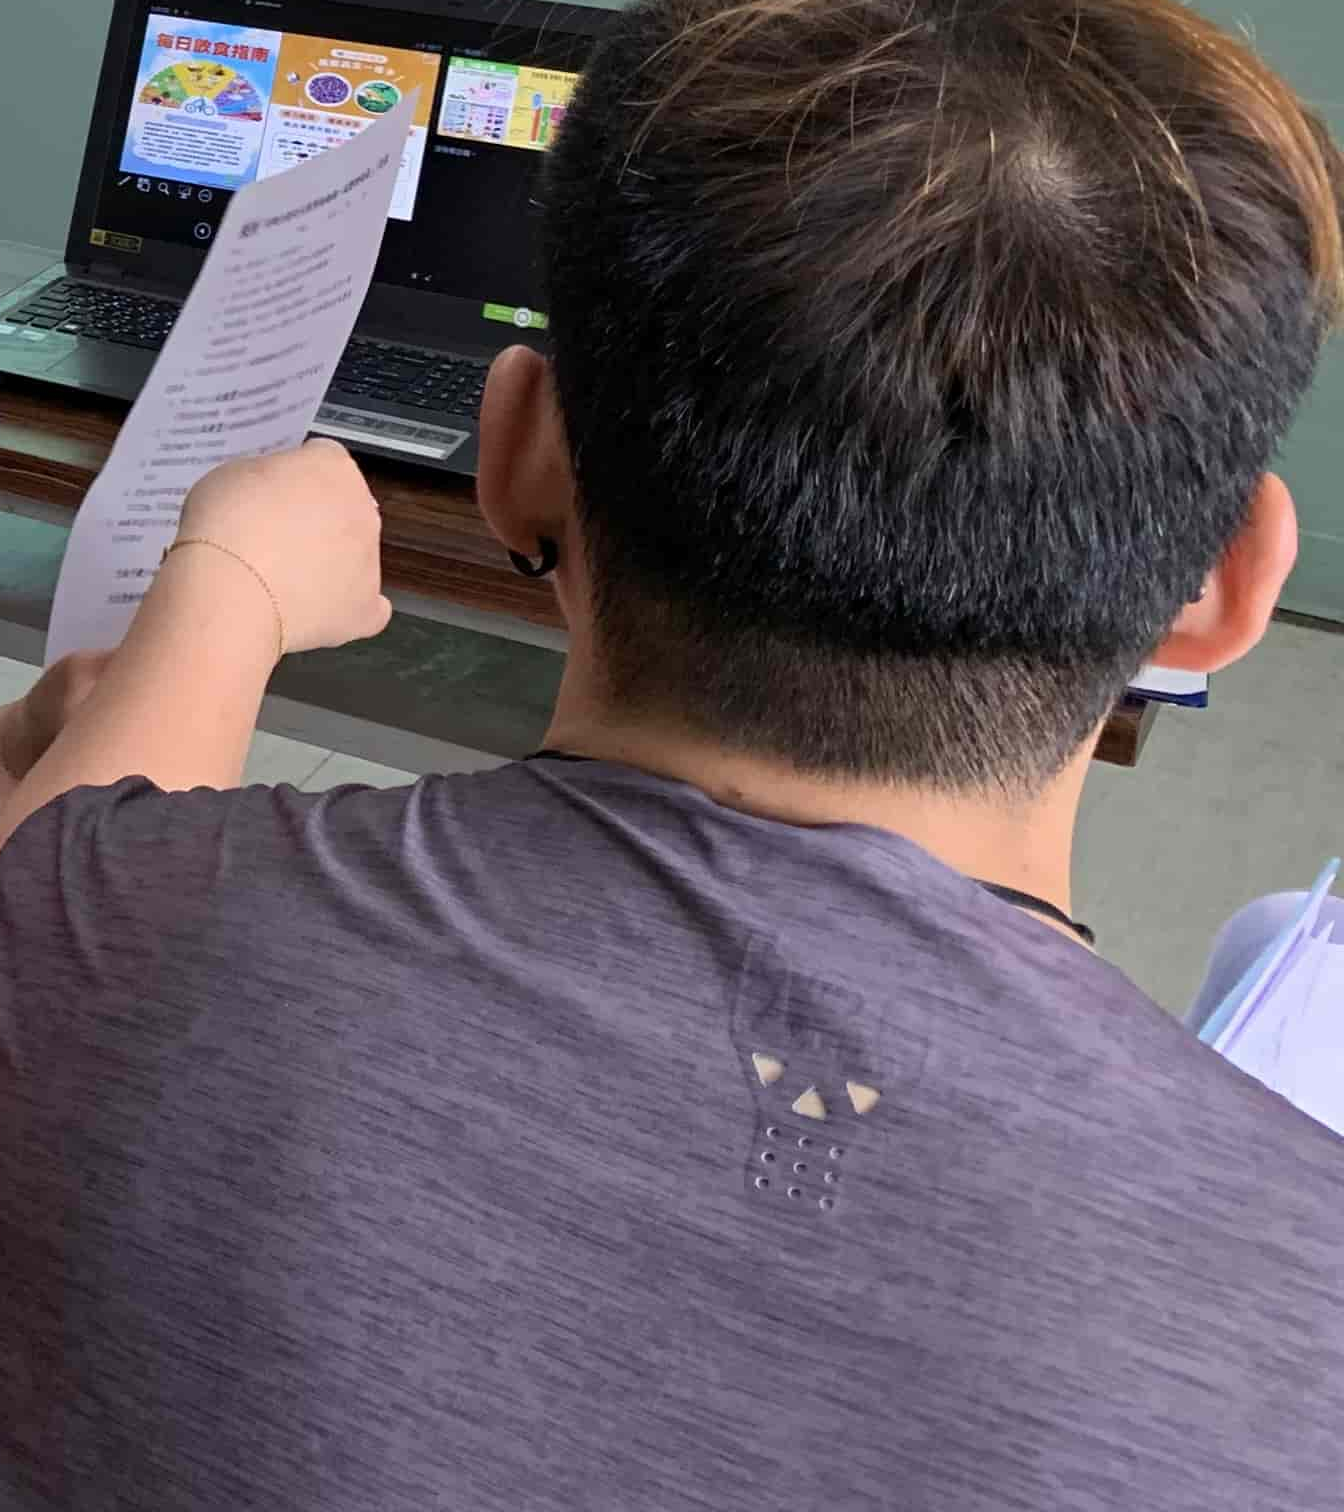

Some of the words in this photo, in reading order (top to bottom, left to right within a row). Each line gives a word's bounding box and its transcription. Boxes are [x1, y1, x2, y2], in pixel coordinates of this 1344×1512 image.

[156, 32, 270, 63] 每日飲食指南
